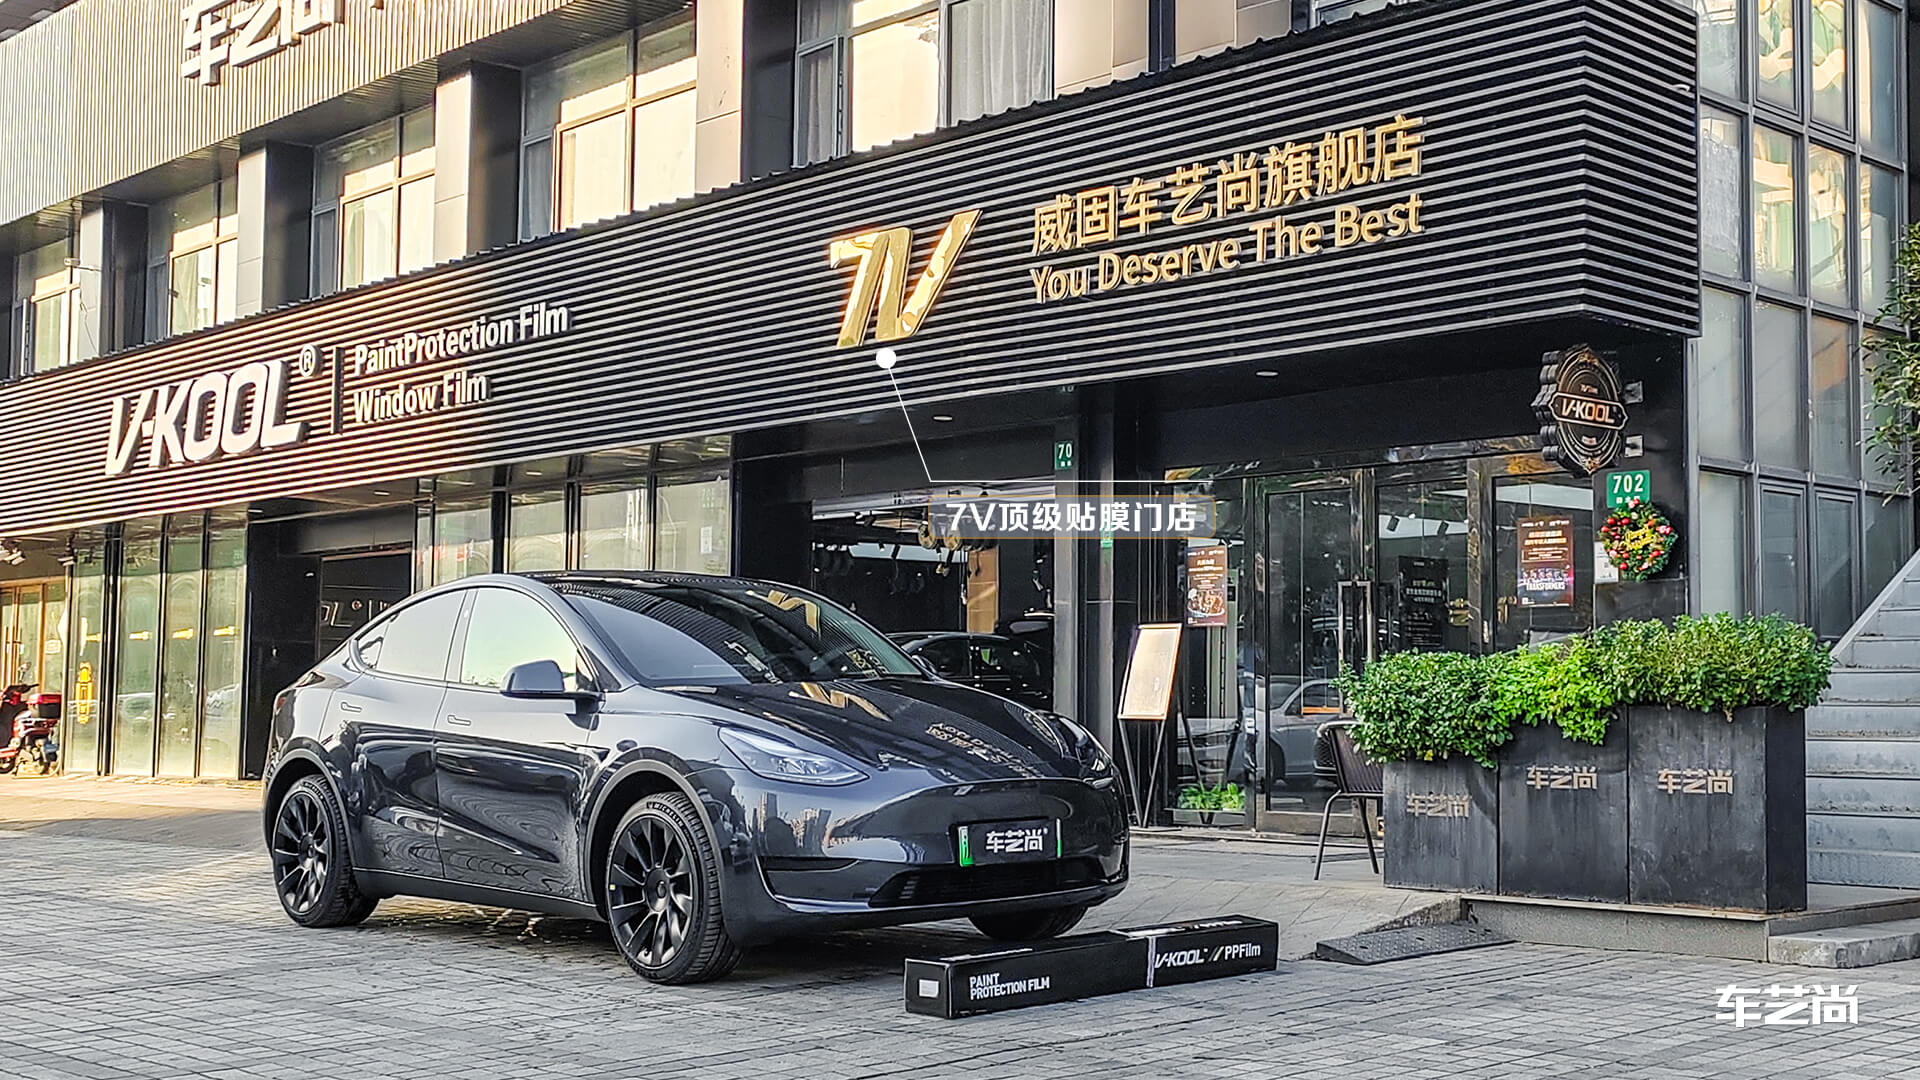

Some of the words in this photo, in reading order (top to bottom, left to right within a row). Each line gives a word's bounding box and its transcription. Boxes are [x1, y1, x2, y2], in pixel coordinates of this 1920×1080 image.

[1031, 113, 1427, 255] 威固车艺尚旗舰店
[1030, 266, 1090, 303] You
[1098, 237, 1240, 292] Deserve
[1249, 215, 1323, 263] The
[1334, 193, 1425, 248] Best
[828, 208, 983, 348] 7V
[519, 302, 570, 341] Film
[353, 383, 438, 424] Window
[442, 370, 489, 408] Film
[1560, 397, 1615, 424] V-KOOL
[1613, 473, 1645, 494] 702
[1526, 764, 1598, 790] 车艺尚
[1657, 768, 1736, 795] 车艺尚
[1406, 792, 1473, 818] 车艺尚
[985, 828, 1043, 853] 车艺尚
[1224, 943, 1261, 960] PPFilm
[969, 973, 1000, 988] PAINT
[969, 980, 1027, 1001] PROTECTION
[1028, 976, 1050, 991] FILM
